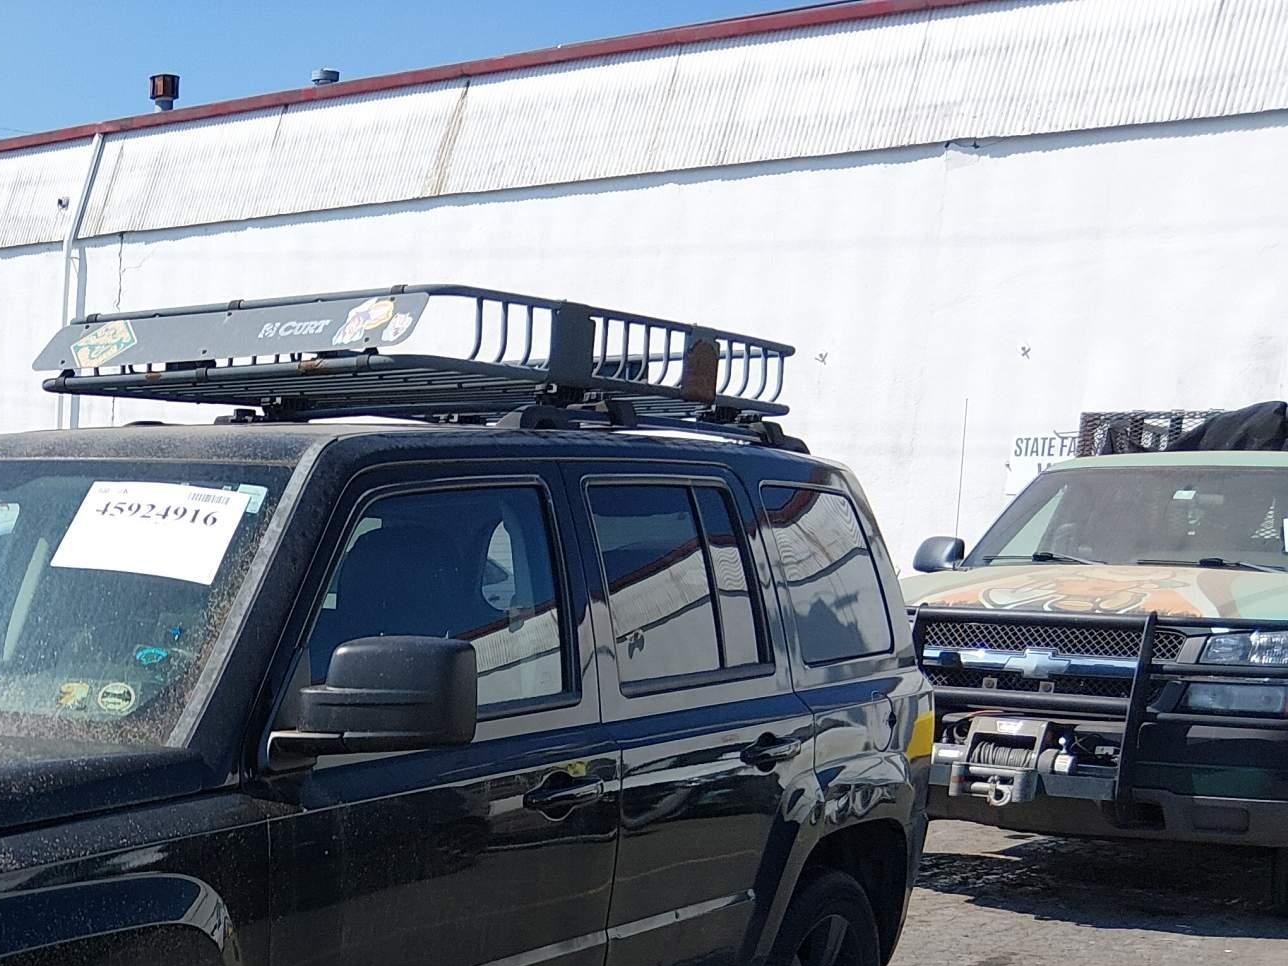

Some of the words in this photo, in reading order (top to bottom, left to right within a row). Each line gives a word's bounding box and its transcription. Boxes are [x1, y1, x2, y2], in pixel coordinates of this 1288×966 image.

[279, 319, 333, 337] CURT
[1014, 437, 1057, 457] STATE
[96, 501, 218, 527] 45924916
